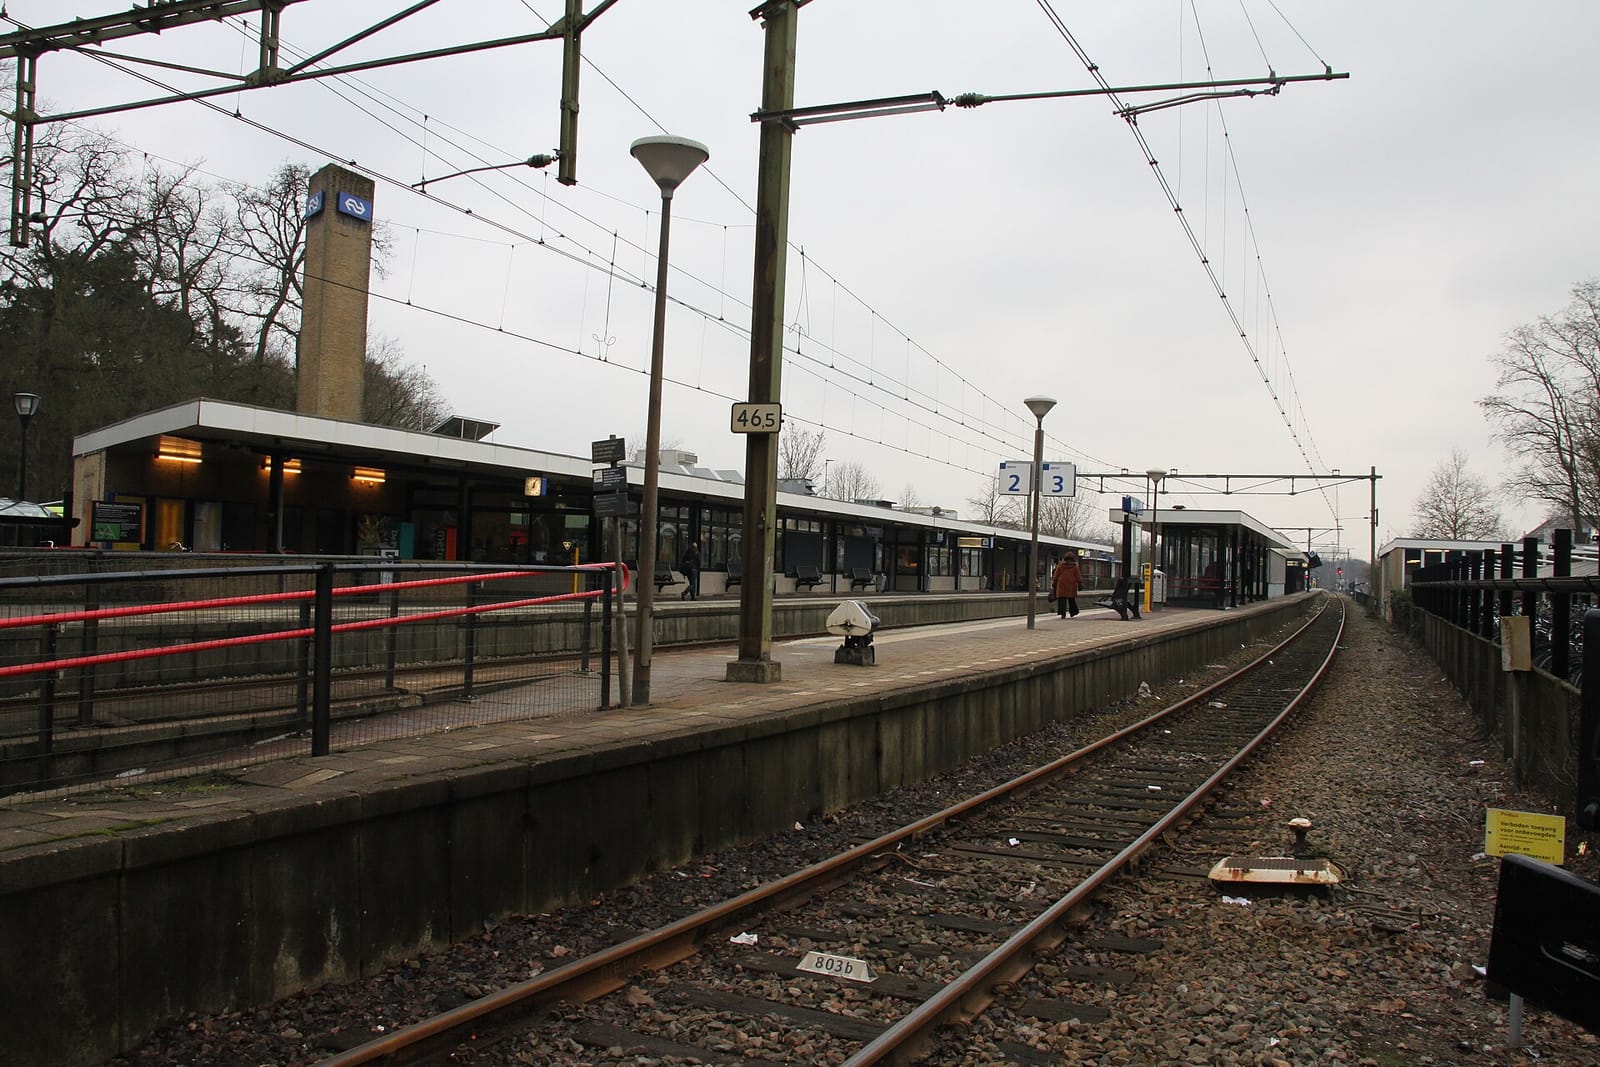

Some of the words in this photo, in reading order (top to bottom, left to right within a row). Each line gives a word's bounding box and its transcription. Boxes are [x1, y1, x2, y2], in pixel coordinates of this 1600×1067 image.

[736, 409, 775, 429] 46,5
[1008, 474, 1020, 492] 2
[1052, 475, 1064, 493] 3
[1500, 821, 1530, 829] Verboden
[1530, 824, 1557, 833] toegang
[1515, 829, 1557, 838] onbevoegden
[815, 956, 853, 975] 803b
